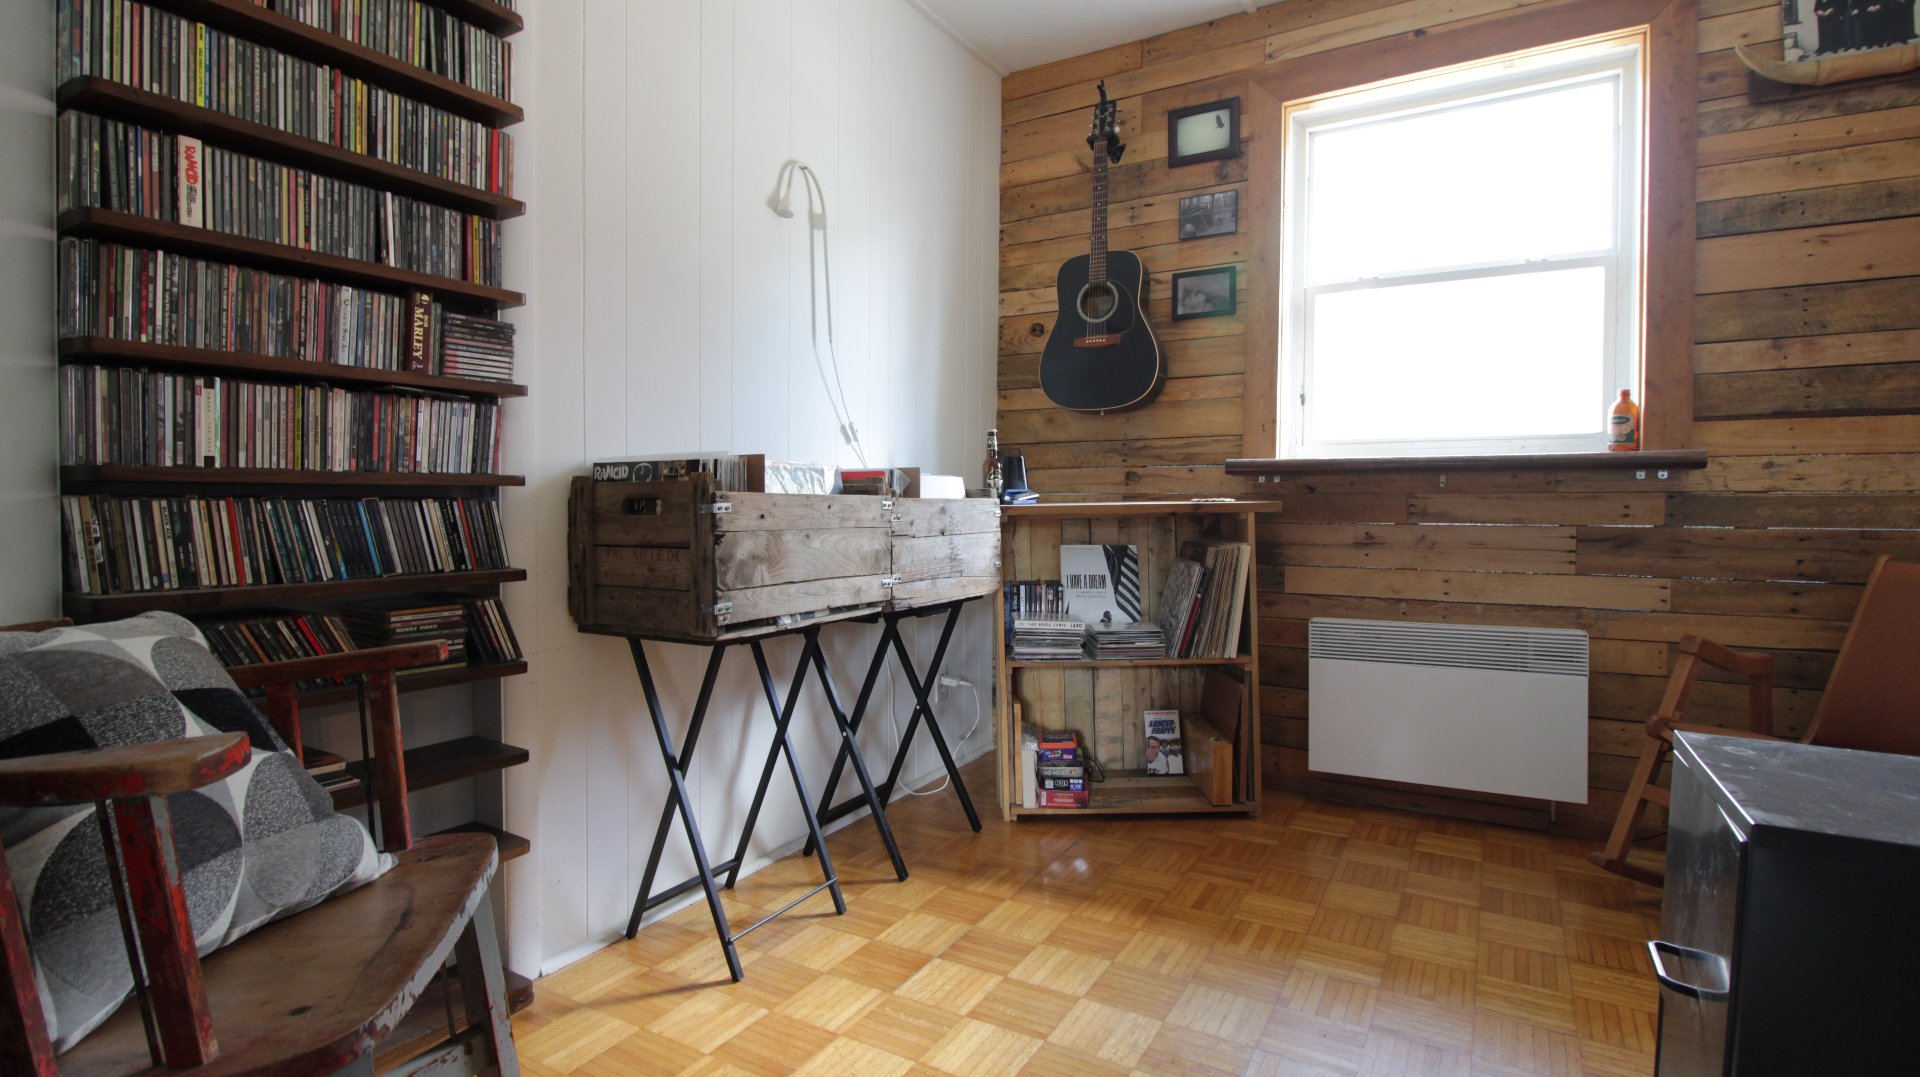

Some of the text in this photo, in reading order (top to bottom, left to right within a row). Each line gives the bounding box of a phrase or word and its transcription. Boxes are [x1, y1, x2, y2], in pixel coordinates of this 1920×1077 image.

[184, 146, 197, 184] RANCID
[412, 306, 425, 360] MARLEY
[594, 464, 629, 481] RANCID
[162, 506, 170, 526] BLACK
[1069, 574, 1082, 589] HAVE
[1083, 574, 1088, 589] A
[1088, 574, 1107, 589] DREAM
